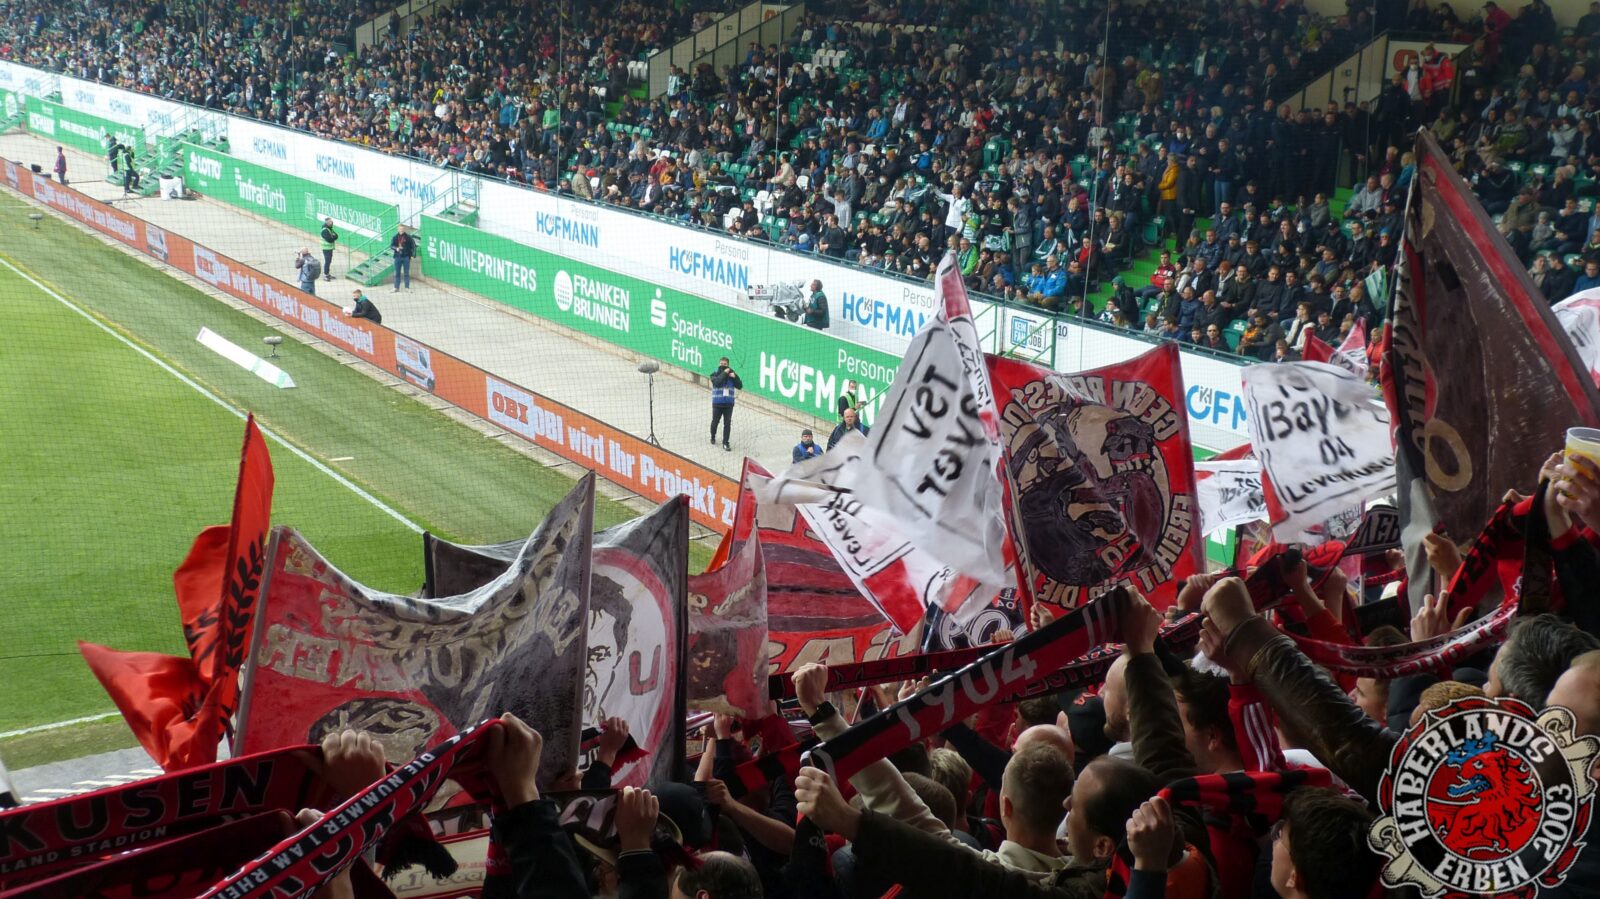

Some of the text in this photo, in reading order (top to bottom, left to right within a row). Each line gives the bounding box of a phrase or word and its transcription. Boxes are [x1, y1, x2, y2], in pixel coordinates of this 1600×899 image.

[253, 136, 287, 160] HOFMANN
[197, 153, 223, 180] LOTTO
[316, 153, 355, 179] HOFMANN
[390, 174, 436, 204] HOFMANN
[317, 198, 347, 222] THOMAS
[536, 210, 599, 248] HOFMANN
[715, 239, 750, 262] Personal
[439, 239, 537, 293] ONLINEPRINTERS
[669, 245, 749, 292] HOFMANN
[197, 254, 215, 276] OBI
[231, 270, 250, 293] wird
[265, 282, 300, 321] Projekt
[300, 303, 321, 330] zum
[321, 308, 375, 356] Heimspiel
[573, 273, 630, 310] FRANKEN
[573, 296, 630, 333] BRUNNEN
[1015, 321, 1027, 332] KEIN
[671, 311, 733, 350] Sparkasse
[1028, 335, 1043, 349] JOB
[1057, 325, 1068, 338] 10
[671, 338, 703, 368] Fürth
[492, 390, 529, 425] OBI
[534, 404, 564, 446] OBI
[567, 425, 605, 466] wird
[609, 439, 635, 480] Ihr
[640, 452, 716, 519] Projekt
[1319, 436, 1356, 466] 04
[403, 752, 436, 775] DIE
[322, 774, 405, 834] NUMMER
[70, 824, 169, 857] STADION
[271, 845, 304, 871] AM
